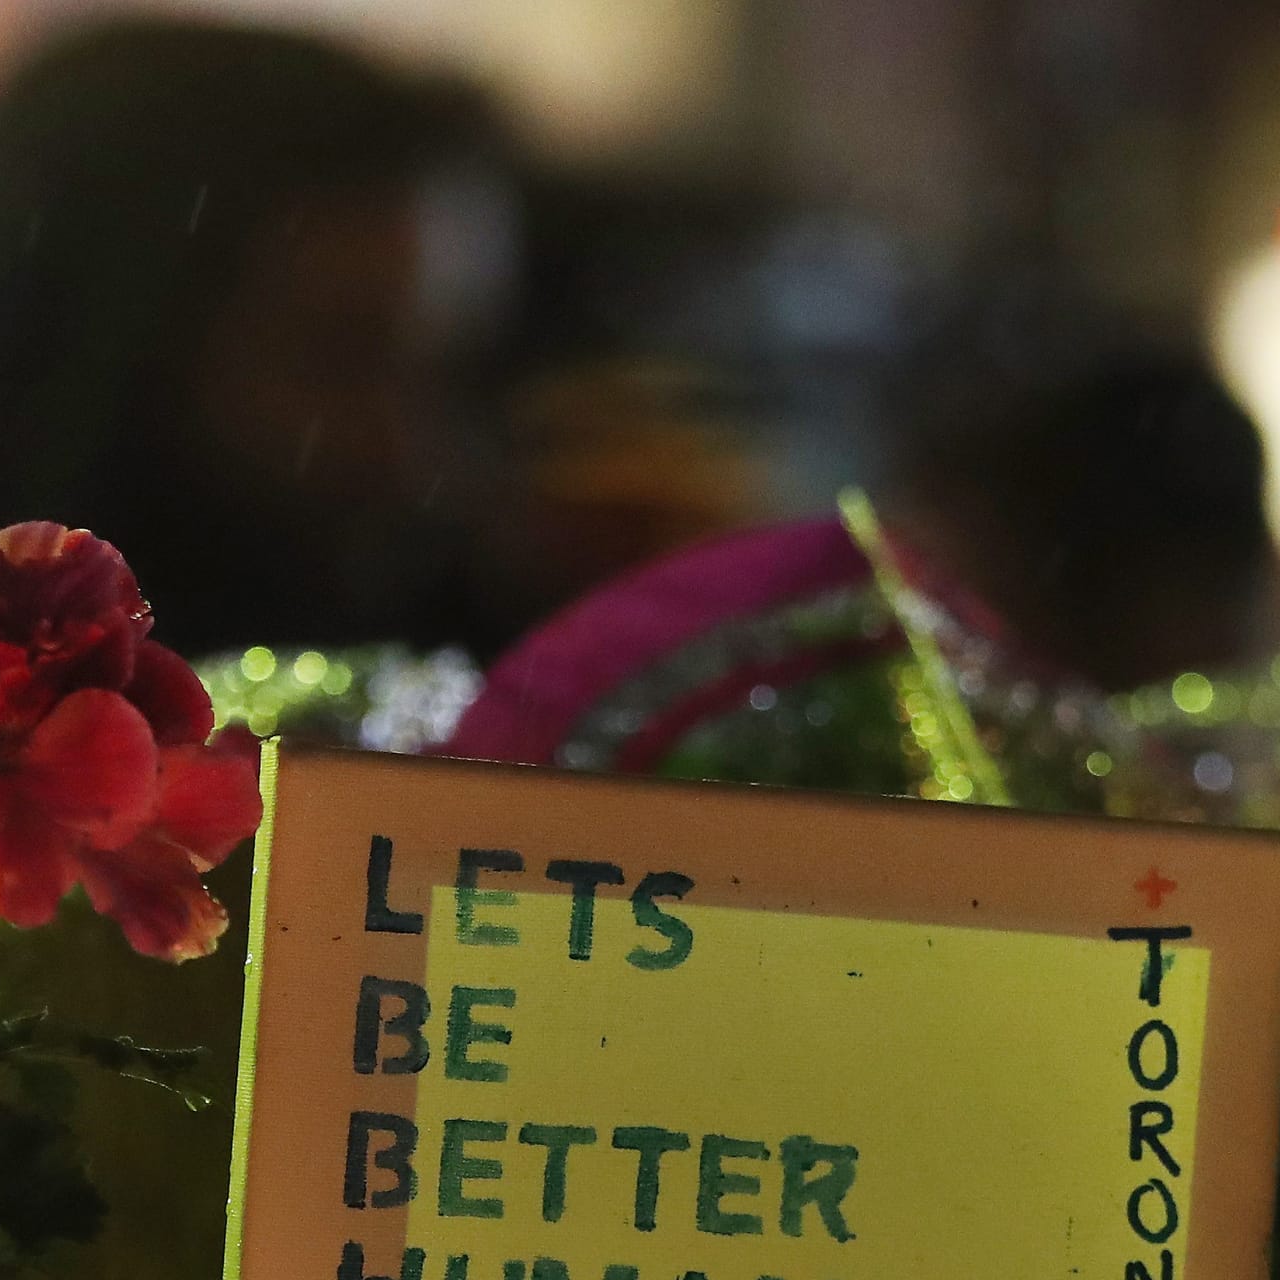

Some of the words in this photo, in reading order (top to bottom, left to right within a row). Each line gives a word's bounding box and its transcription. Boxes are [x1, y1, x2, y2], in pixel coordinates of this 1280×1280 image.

[363, 833, 696, 973] LETS
[351, 974, 519, 1082] BE
[341, 1109, 861, 1243] BETTER
